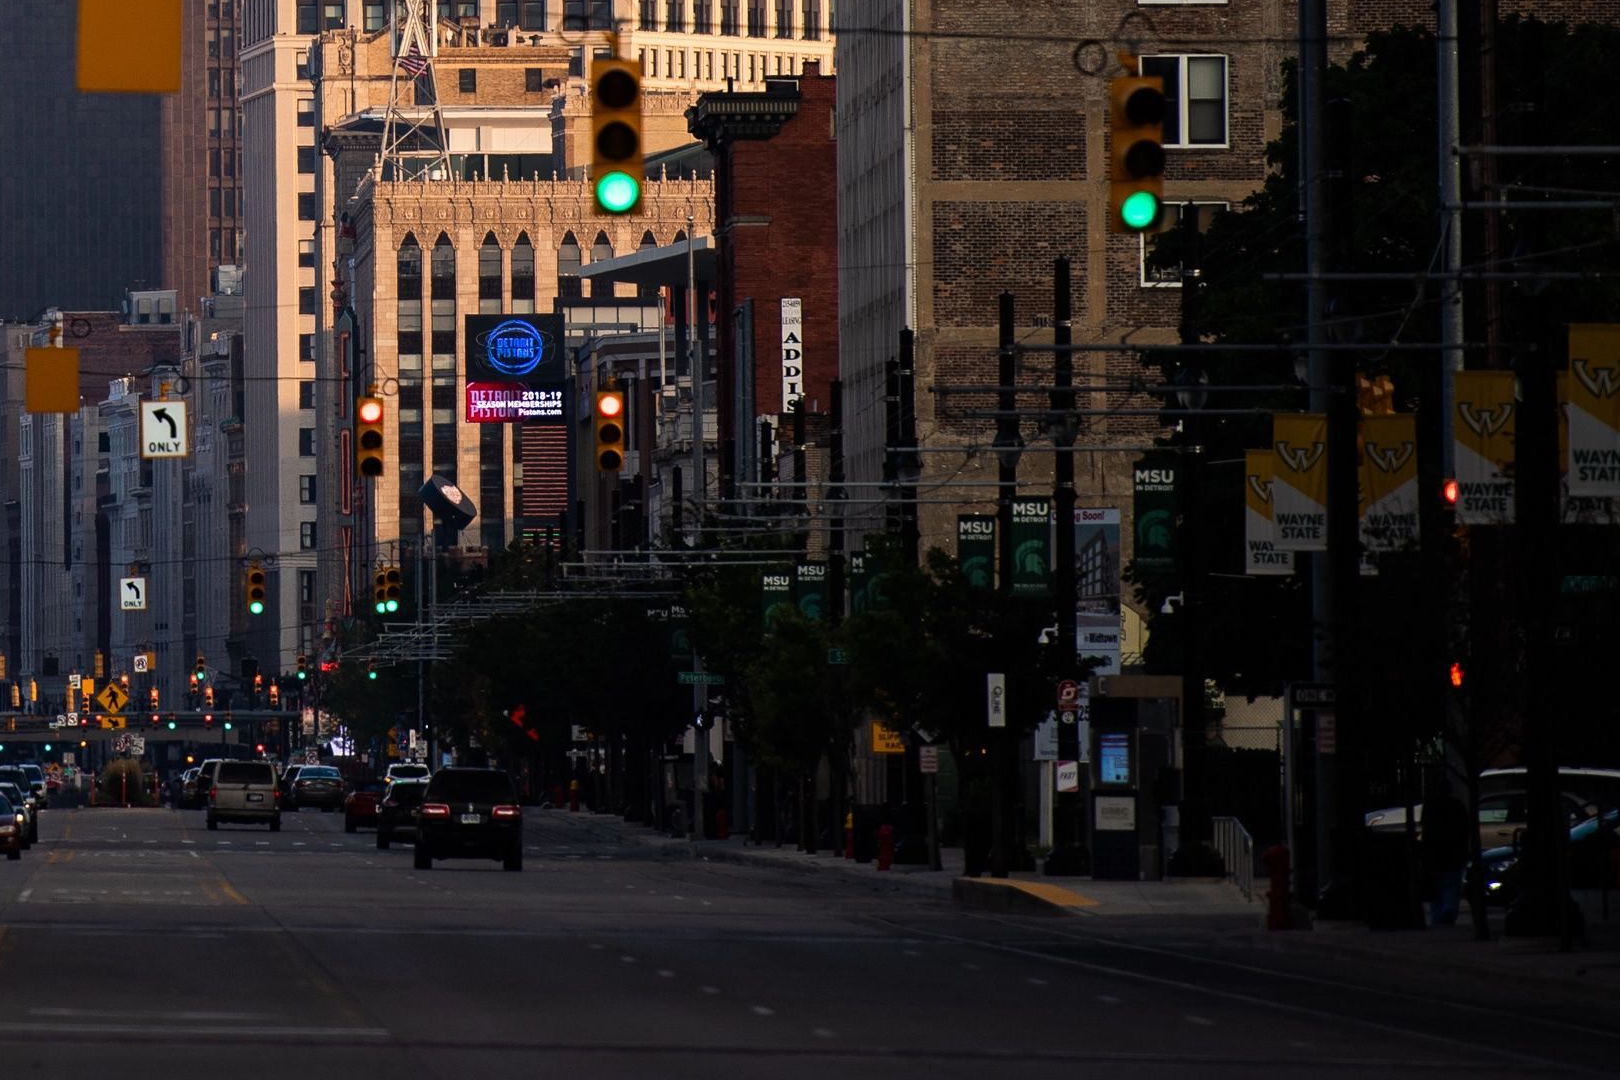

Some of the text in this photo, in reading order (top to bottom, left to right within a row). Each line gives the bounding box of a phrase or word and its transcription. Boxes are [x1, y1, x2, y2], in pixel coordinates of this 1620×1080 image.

[522, 391, 562, 400] 2018-19
[476, 400, 562, 408] SEASON MEMBERSHIPS
[518, 408, 562, 416] Pistons.com
[149, 442, 180, 453] ONLY
[1574, 450, 1620, 464] WAYN
[1135, 469, 1174, 483] MSU
[1460, 483, 1512, 496] WAYNE
[1012, 502, 1048, 515] MSU
[1466, 498, 1507, 511] STATE
[1082, 511, 1105, 521] Soon!
[1277, 514, 1325, 526] WAYNE
[959, 521, 993, 534] MSU
[1282, 527, 1320, 539] STATE
[1249, 541, 1275, 550] WAY
[1253, 553, 1289, 564] STATE
[797, 566, 825, 576] MSU
[763, 576, 789, 585] MSU
[1089, 633, 1118, 643] Midtown
